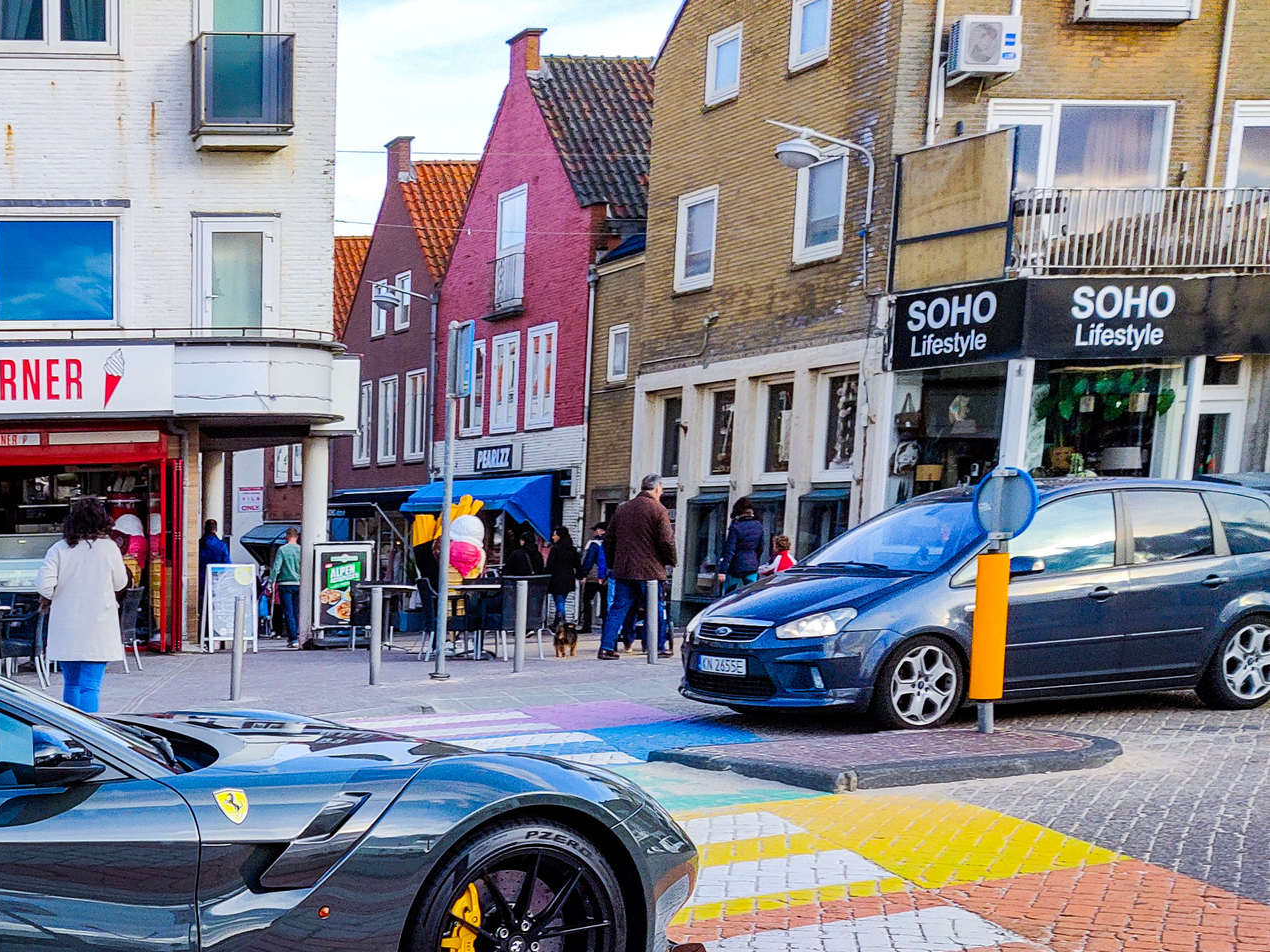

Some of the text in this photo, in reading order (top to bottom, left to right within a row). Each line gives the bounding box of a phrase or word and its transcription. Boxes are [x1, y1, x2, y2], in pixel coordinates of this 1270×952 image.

[907, 291, 997, 332] SOHO
[1071, 285, 1176, 319] SOHO
[910, 329, 987, 358] Lifestyle
[1075, 323, 1164, 351] Lifestyle
